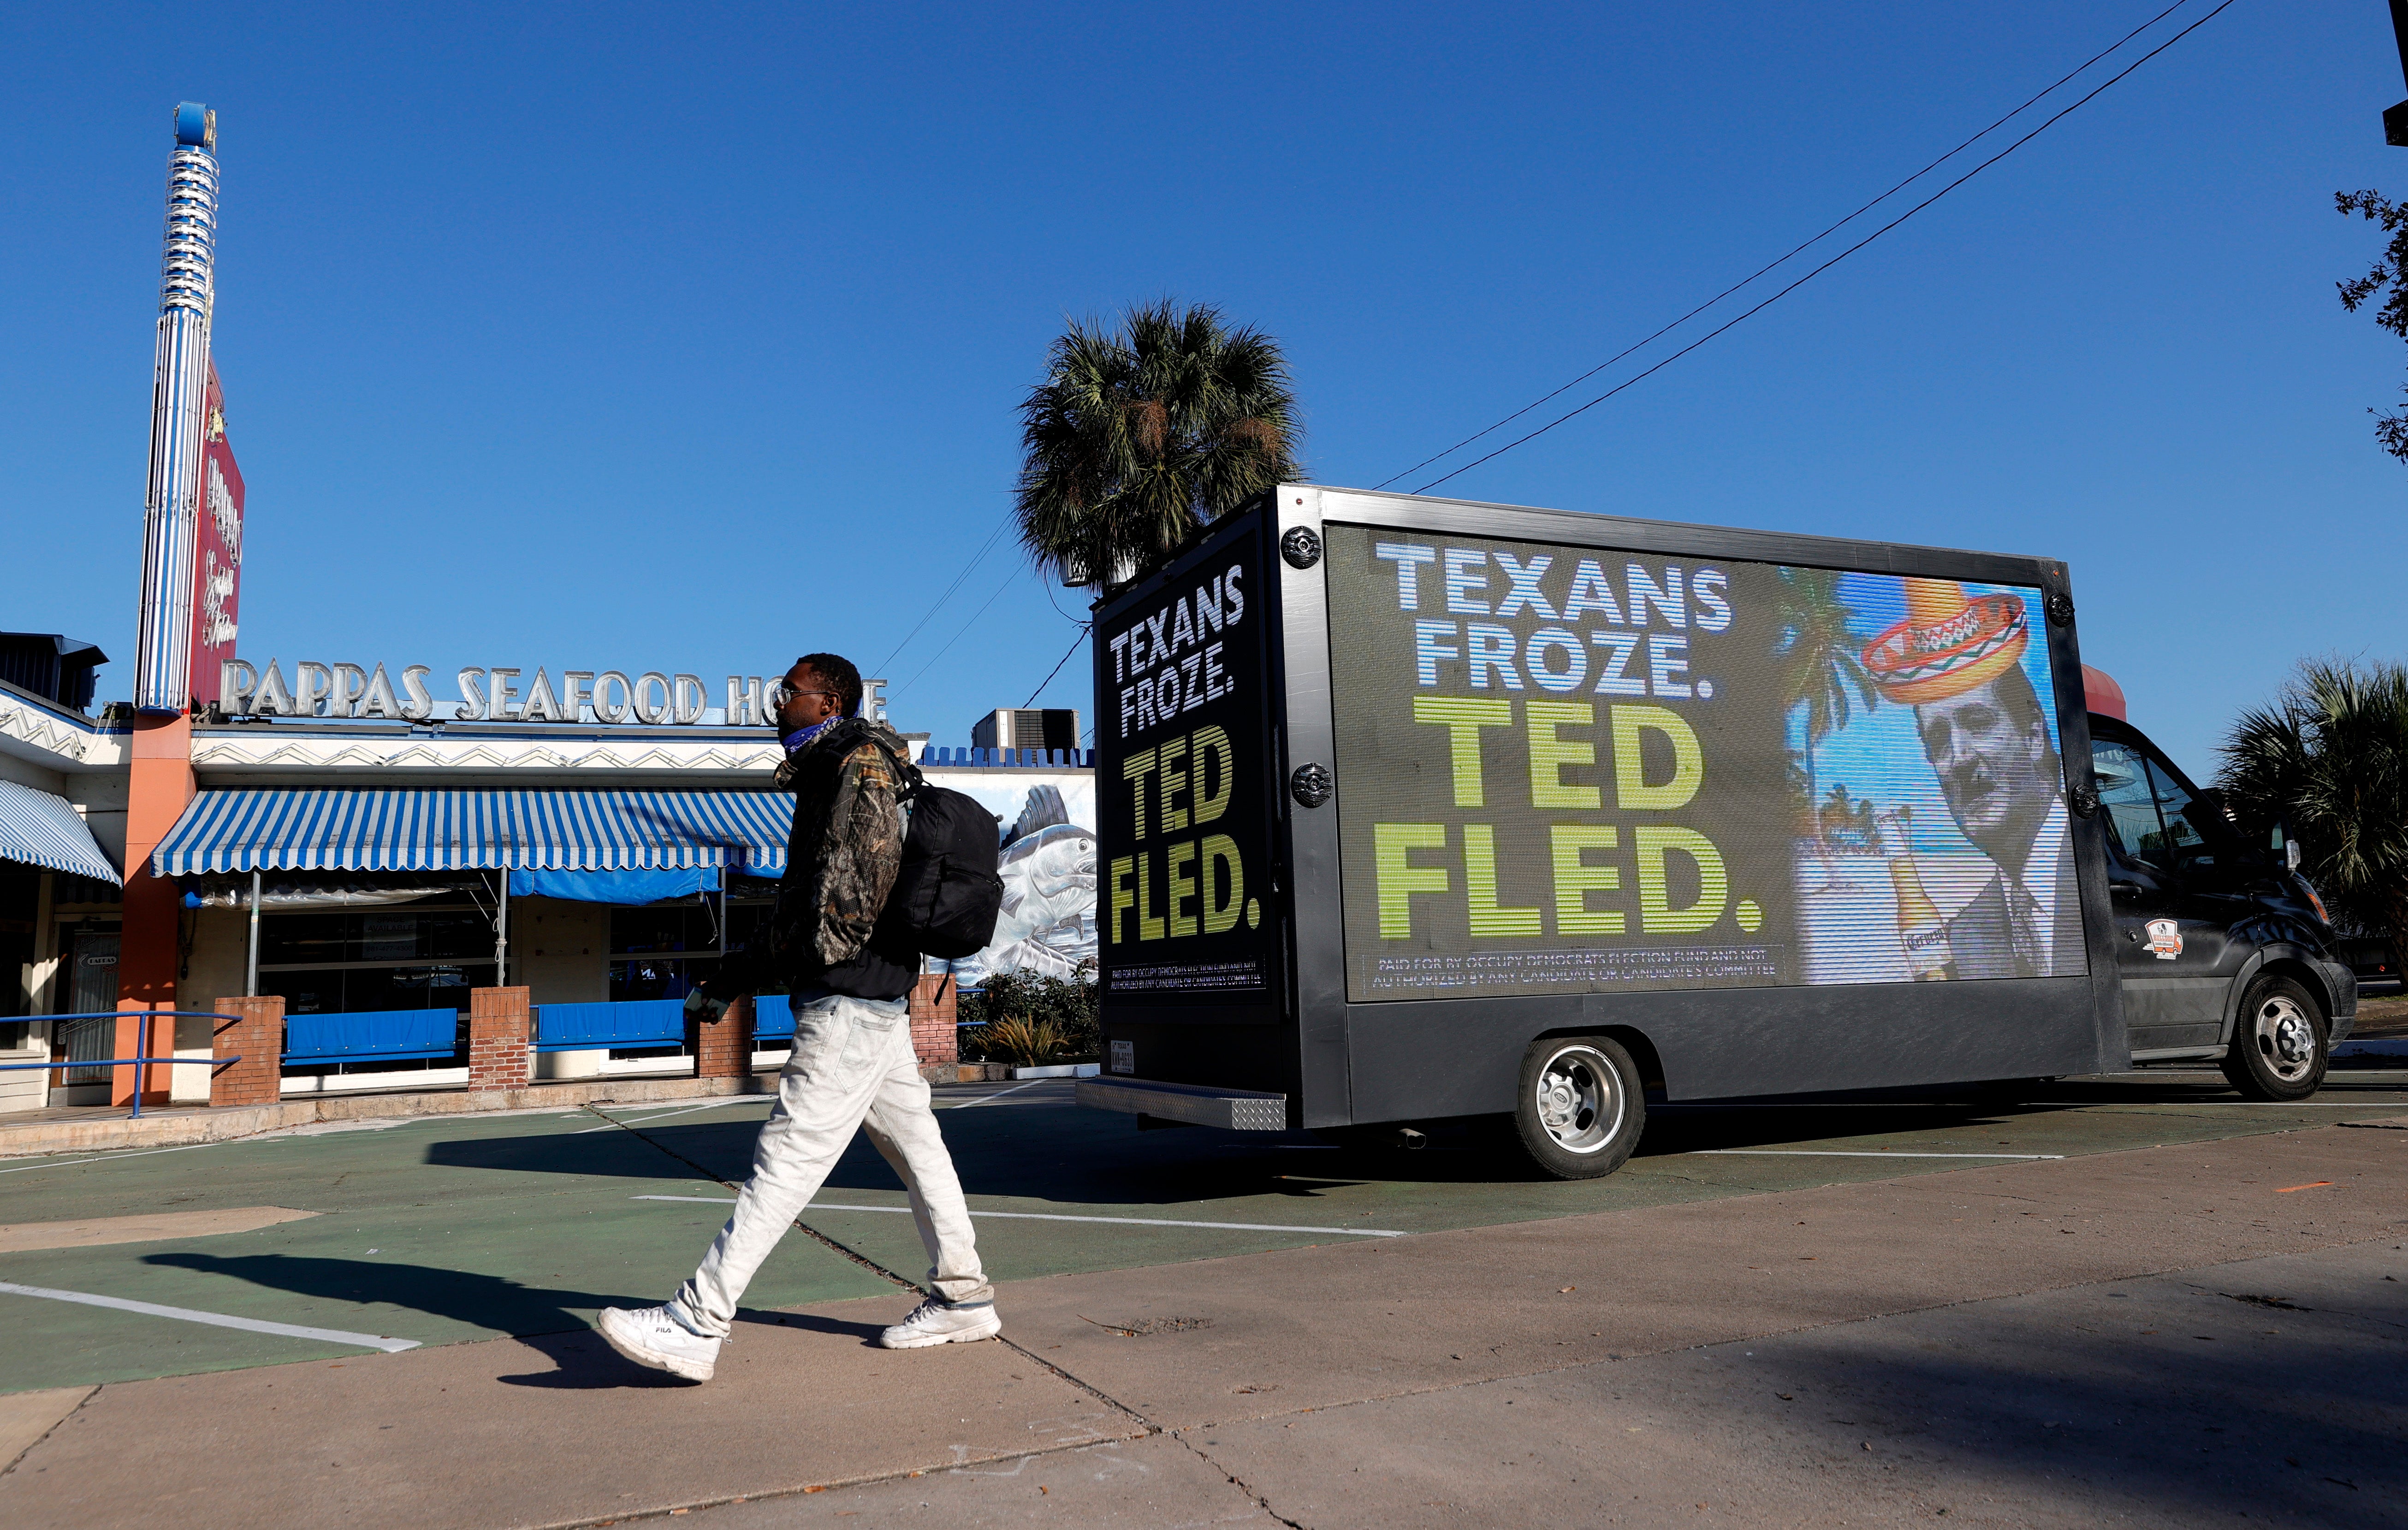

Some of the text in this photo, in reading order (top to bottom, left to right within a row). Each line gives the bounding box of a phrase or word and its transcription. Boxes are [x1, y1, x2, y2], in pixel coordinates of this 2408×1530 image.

[1110, 565, 1244, 685] TEXANS
[1376, 542, 1732, 632] TEXANS
[220, 657, 888, 725] PAPPAS SEAFOOD HOE
[1121, 641, 1234, 738] FROZE.
[1415, 619, 1713, 698] FROZE.
[1124, 725, 1233, 840] TED
[1413, 696, 1702, 809] TED
[1111, 834, 1260, 944] FLED.
[1374, 823, 1762, 939] FLED.
[1112, 970, 1121, 978] PAID
[1123, 969, 1131, 978] FOR
[1373, 973, 1465, 987] AUTHORIZED
[1488, 970, 1516, 983] ANY
[1379, 950, 1767, 970] PAID FOR BY OCCUPY DEMOCRATS ELECTION FUND AND NOT
